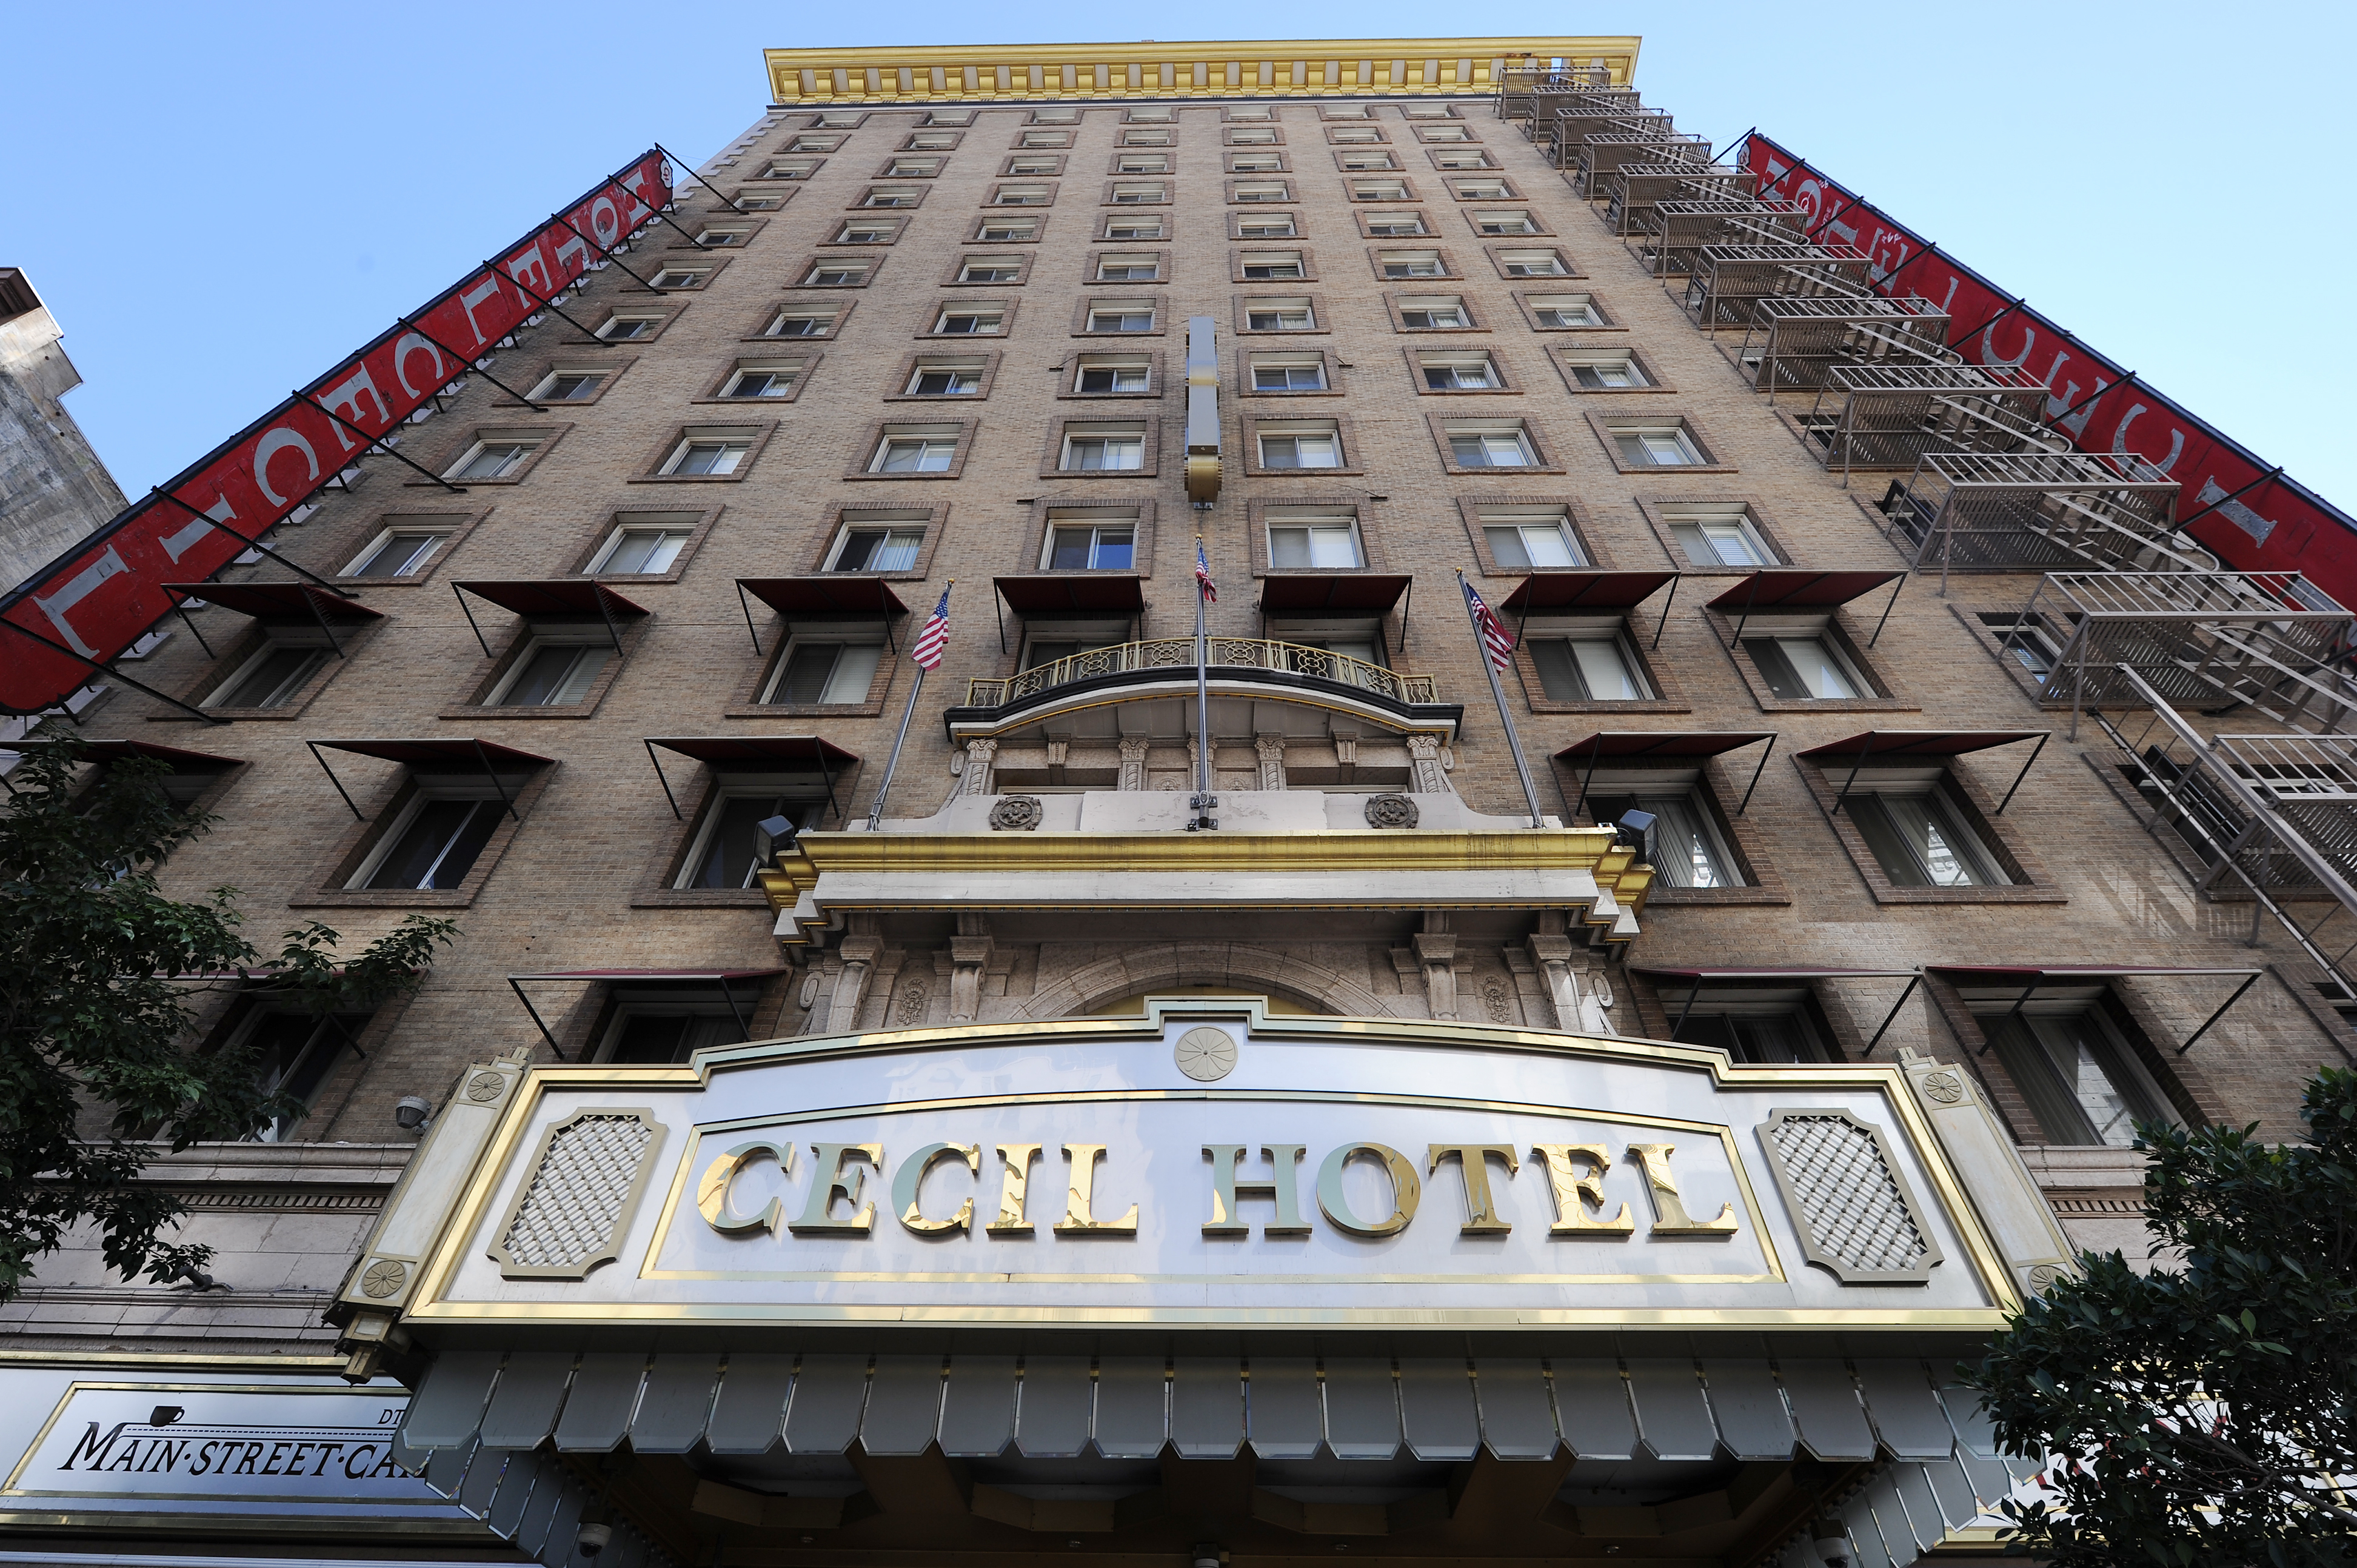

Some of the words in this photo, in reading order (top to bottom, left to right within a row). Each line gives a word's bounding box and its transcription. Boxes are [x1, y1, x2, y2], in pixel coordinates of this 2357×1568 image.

[459, 167, 652, 344] HOTEL
[32, 332, 444, 659] CECIL
[696, 1139, 1140, 1238] CECIL
[1199, 1139, 1740, 1239] HOTEL
